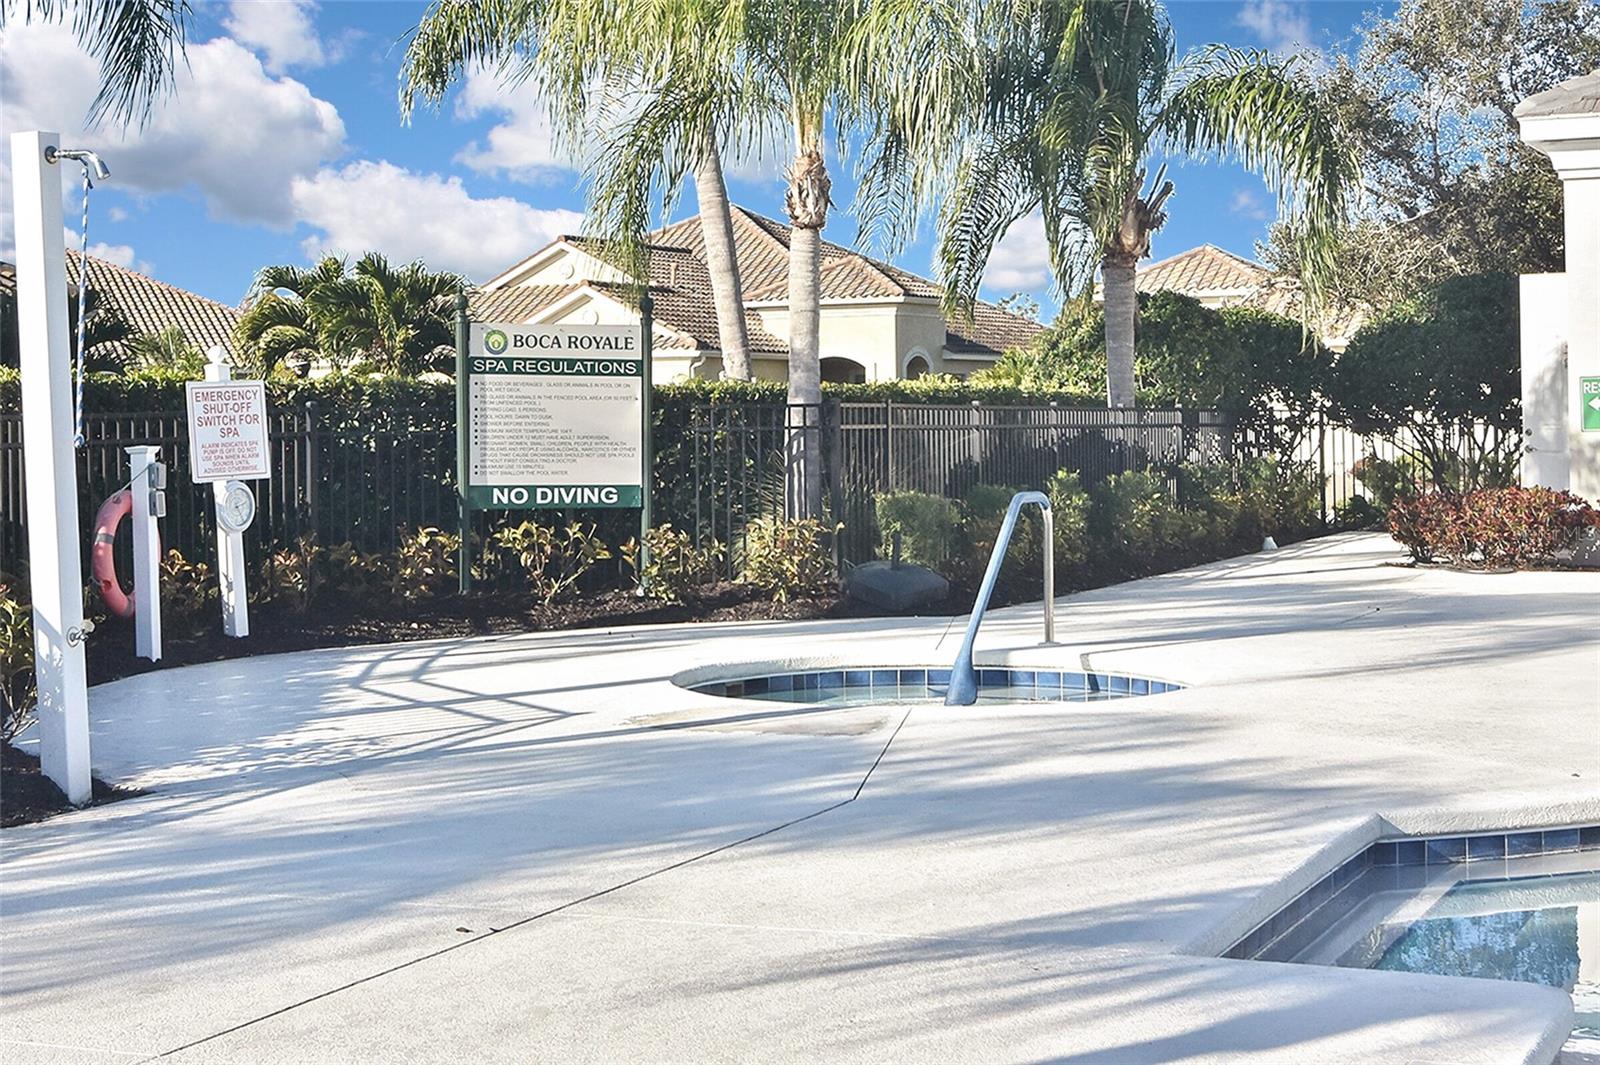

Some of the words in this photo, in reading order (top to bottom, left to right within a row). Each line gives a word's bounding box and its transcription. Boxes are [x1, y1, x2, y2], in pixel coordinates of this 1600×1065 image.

[513, 334, 561, 348] BOCA
[568, 336, 634, 350] ROYALE
[474, 359, 508, 372] SPA
[513, 360, 636, 374] REGULATIONS
[195, 390, 258, 402] EMERGENCY
[203, 402, 252, 414] SHUT-OFF
[197, 416, 236, 427] SWITCH
[239, 414, 260, 425] FOR
[220, 428, 240, 438] SPA
[493, 488, 528, 504] NO
[536, 488, 618, 504] DIVING
